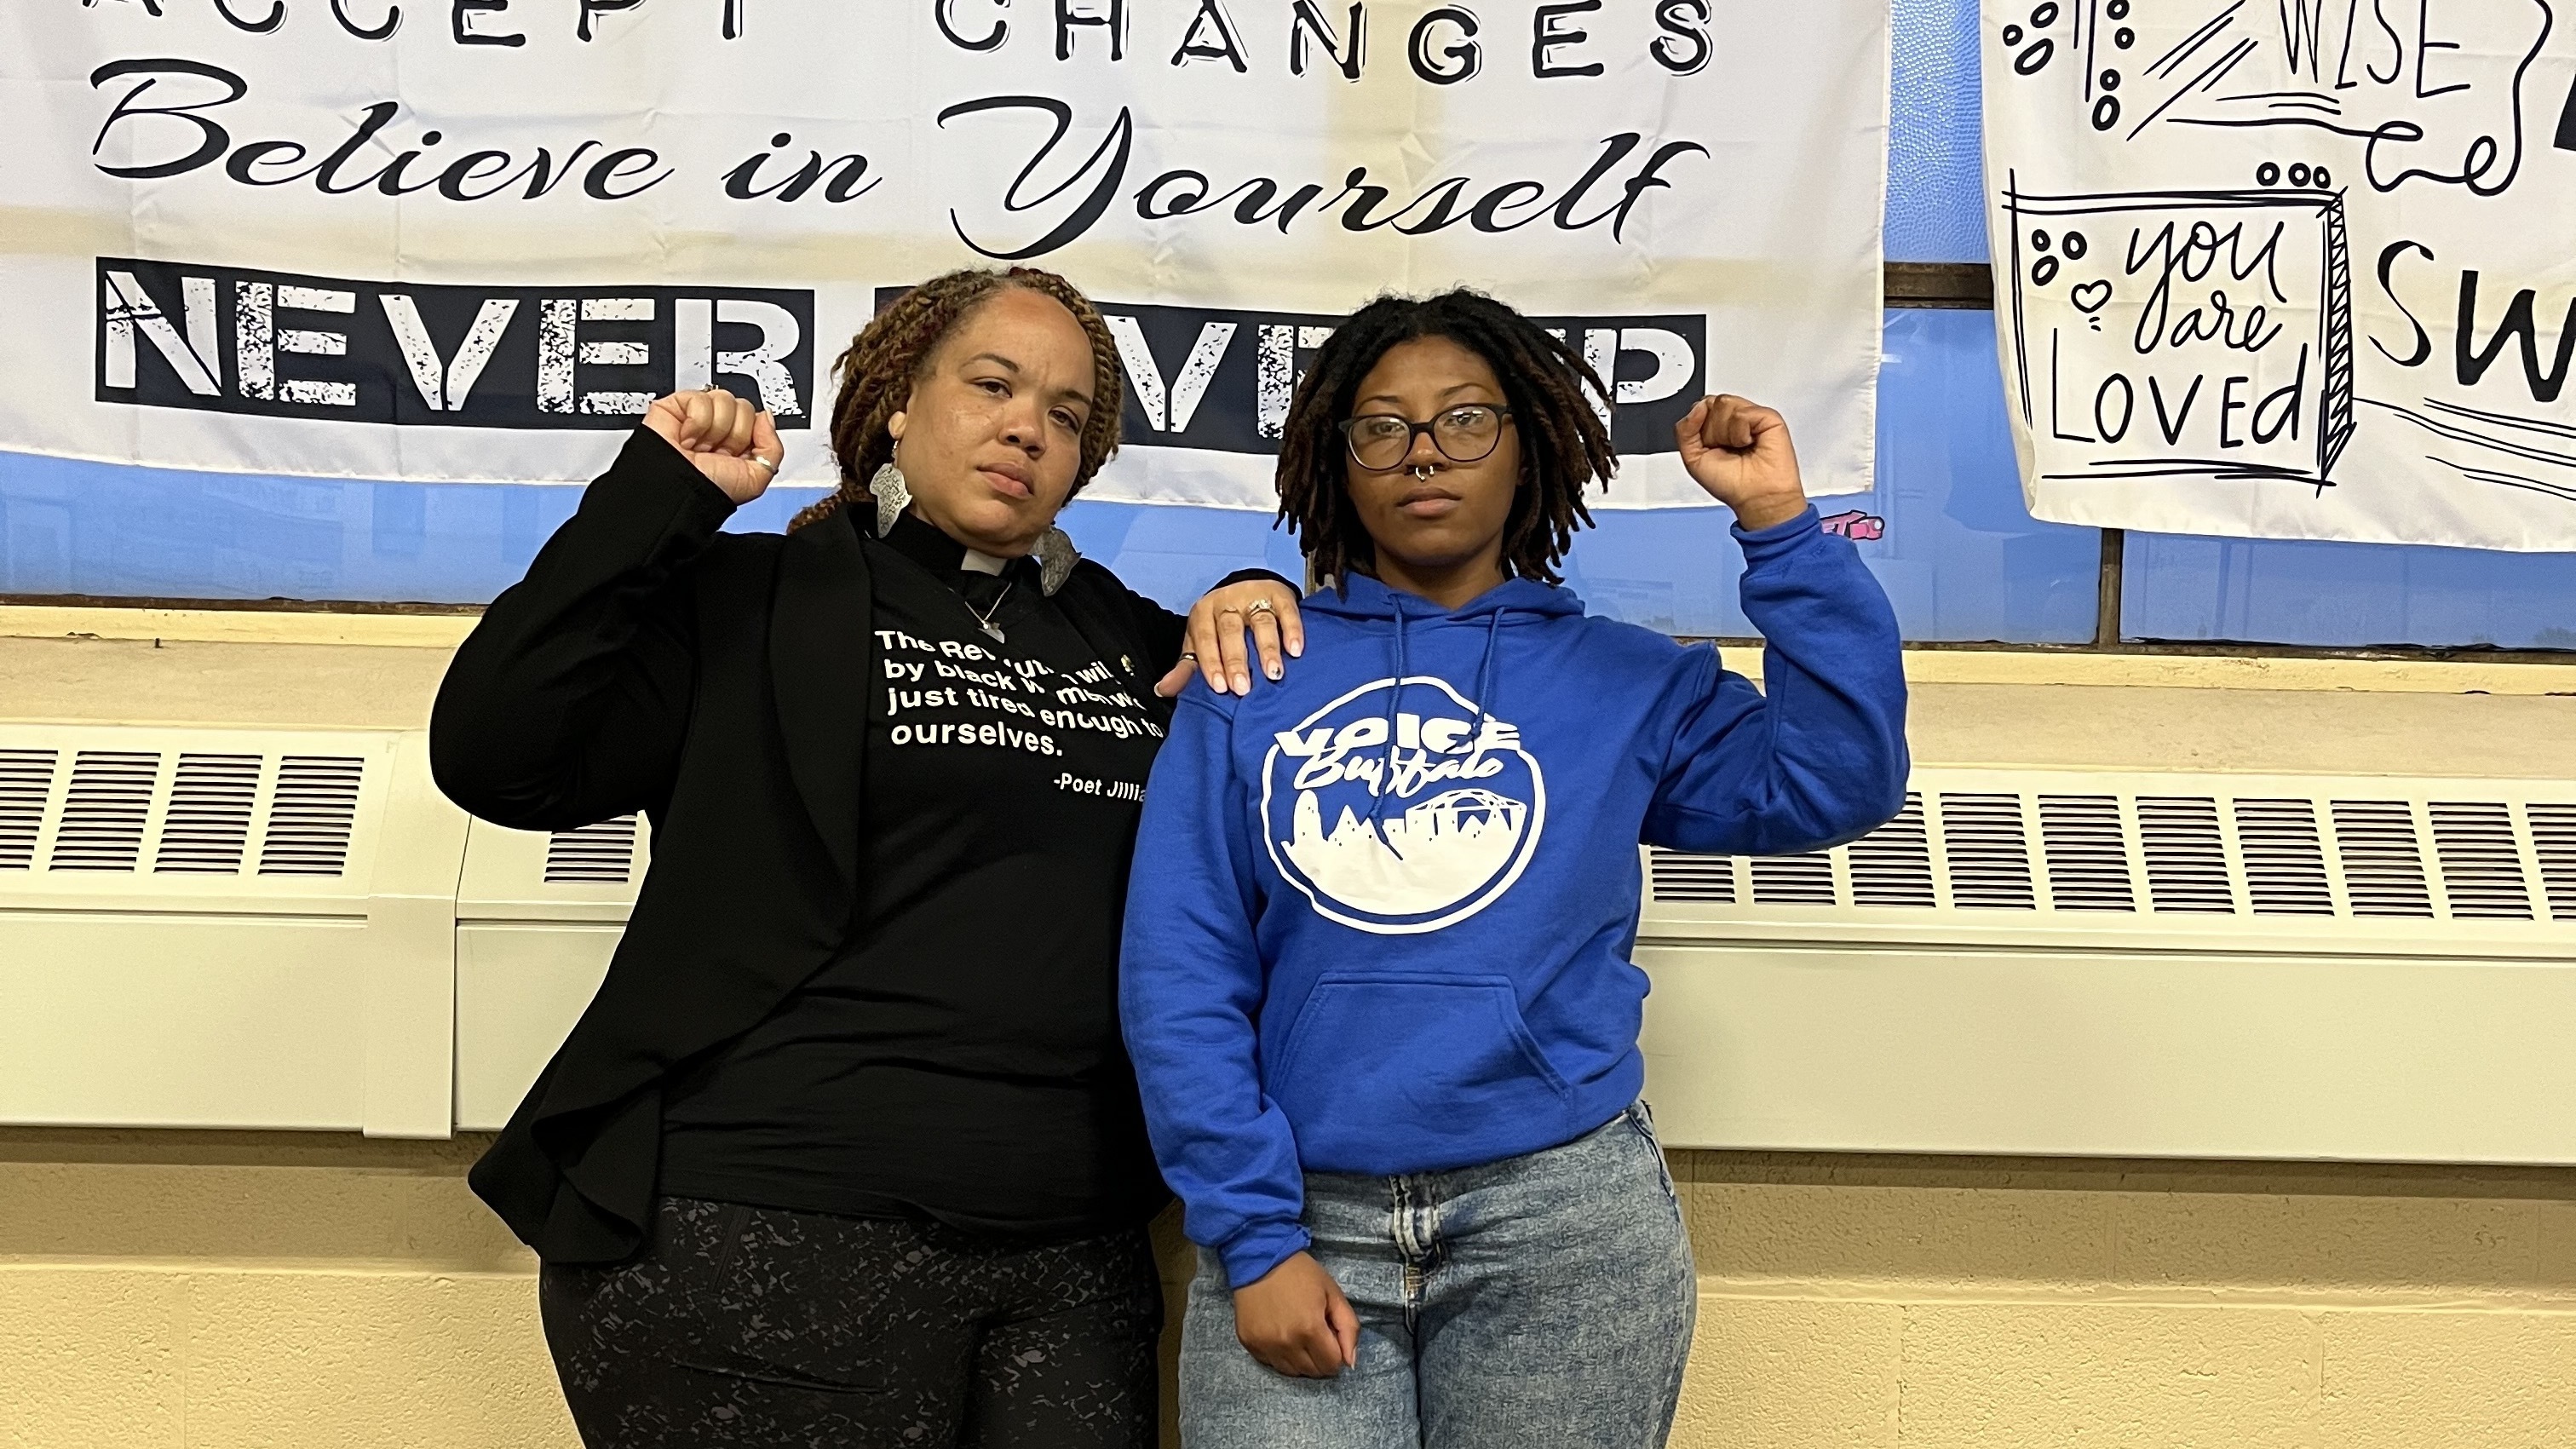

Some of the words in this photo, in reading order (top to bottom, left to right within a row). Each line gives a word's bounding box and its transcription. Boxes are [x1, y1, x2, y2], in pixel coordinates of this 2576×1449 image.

[82, 0, 744, 47] CEP
[935, 0, 1714, 84] CHANGES
[2280, 0, 2471, 98] WISE
[90, 59, 675, 202] Believe
[722, 133, 883, 203] in
[937, 95, 1711, 260] Yourself
[2125, 221, 2287, 354] you
[2171, 290, 2283, 352] are
[106, 270, 806, 418] NEVER
[1102, 314, 1337, 440] VE
[1544, 328, 1695, 441] P
[874, 630, 936, 653] The
[884, 658, 925, 682] by
[934, 660, 1017, 691] black
[888, 687, 959, 716] just
[1039, 709, 1143, 739] enough
[891, 721, 1063, 756] ourselves.
[1274, 712, 1521, 755] VOICE
[1054, 772, 1102, 796] -Poet
[1293, 746, 1504, 798] Buffalo
